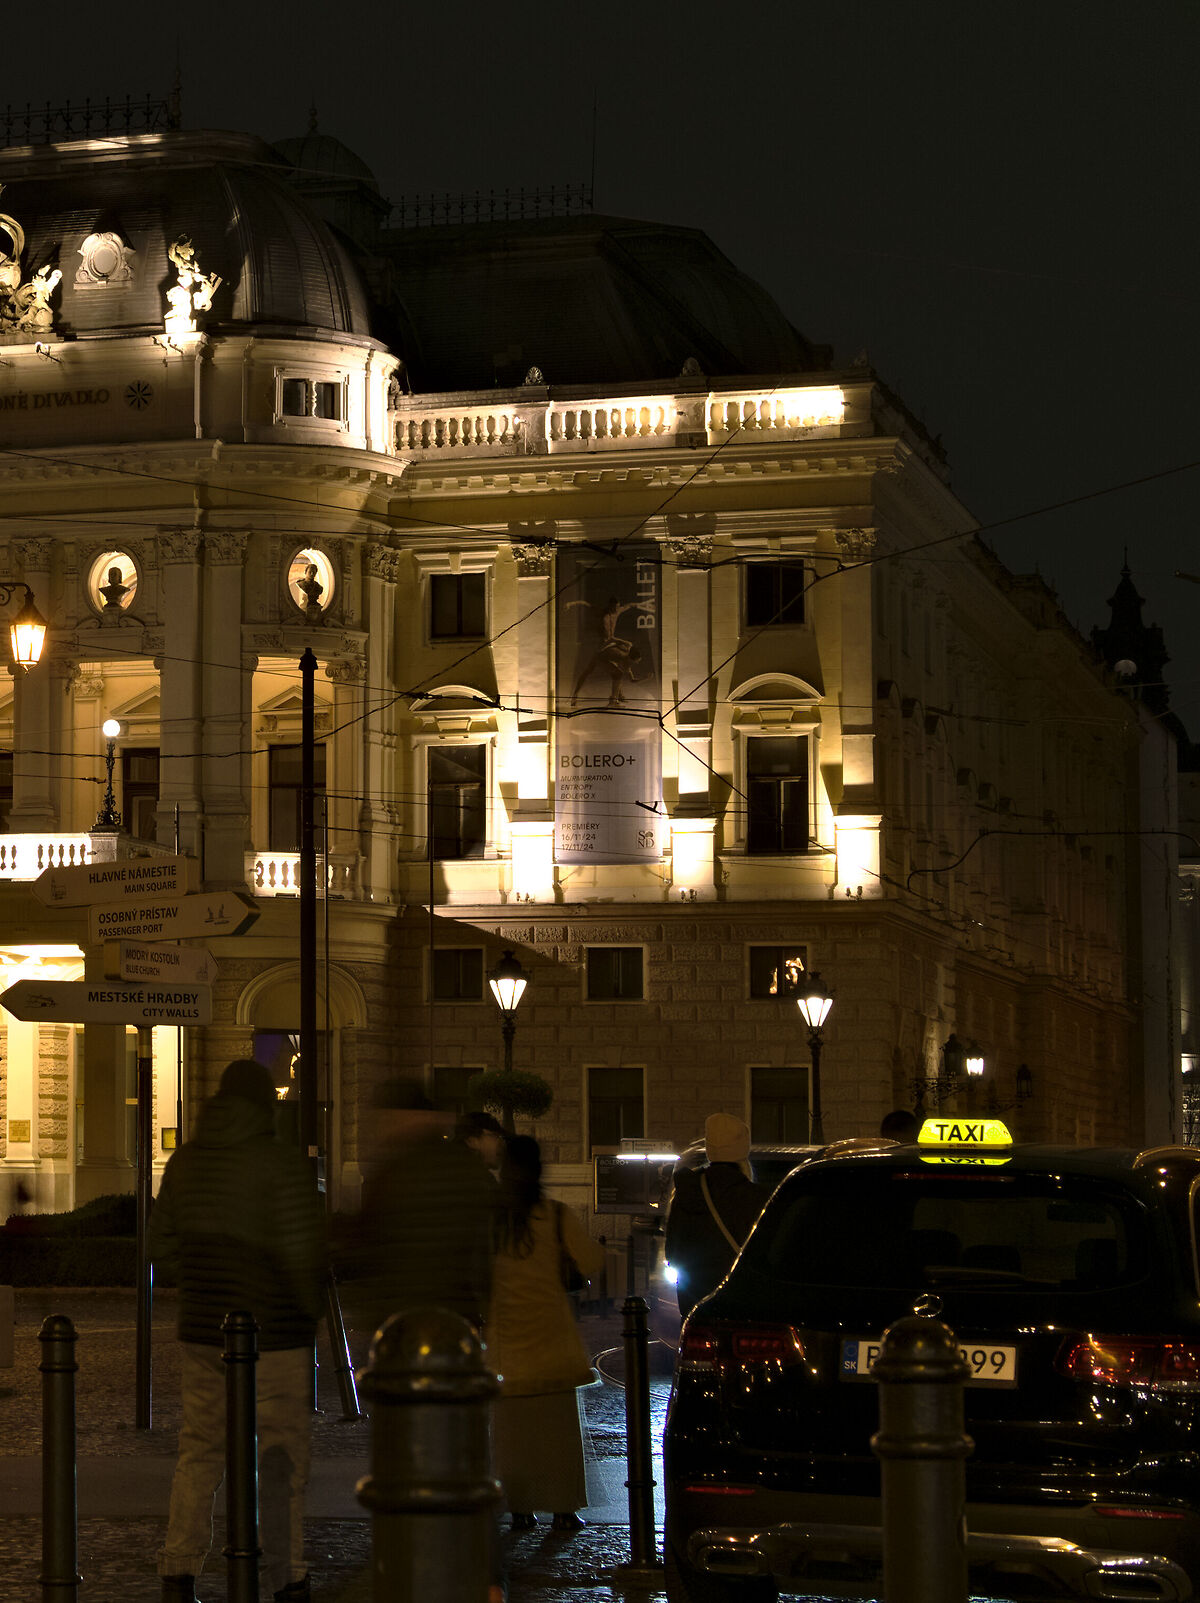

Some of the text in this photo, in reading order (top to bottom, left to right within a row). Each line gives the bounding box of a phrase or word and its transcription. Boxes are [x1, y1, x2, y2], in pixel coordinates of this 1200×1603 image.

[33, 389, 110, 409] DIVADLO
[637, 558, 657, 629] BALET
[561, 754, 636, 768] BOLERO+
[561, 833, 596, 841] 16/11/24
[561, 843, 594, 851] 17/11/24
[89, 865, 177, 884] HLAVNÉ NÁMESTIE
[124, 880, 177, 894] MAIN SQUARE
[98, 906, 178, 924] OSOBNÝ PRÍSTAV
[98, 923, 163, 937] PASSENGER PORT
[125, 964, 161, 976] BLUE CHURCH
[88, 990, 198, 1004] MESTSKÉ HRADBY
[142, 1008, 199, 1018] CITY WALLS
[936, 1124, 984, 1142] TAXI
[844, 1361, 856, 1369] SK
